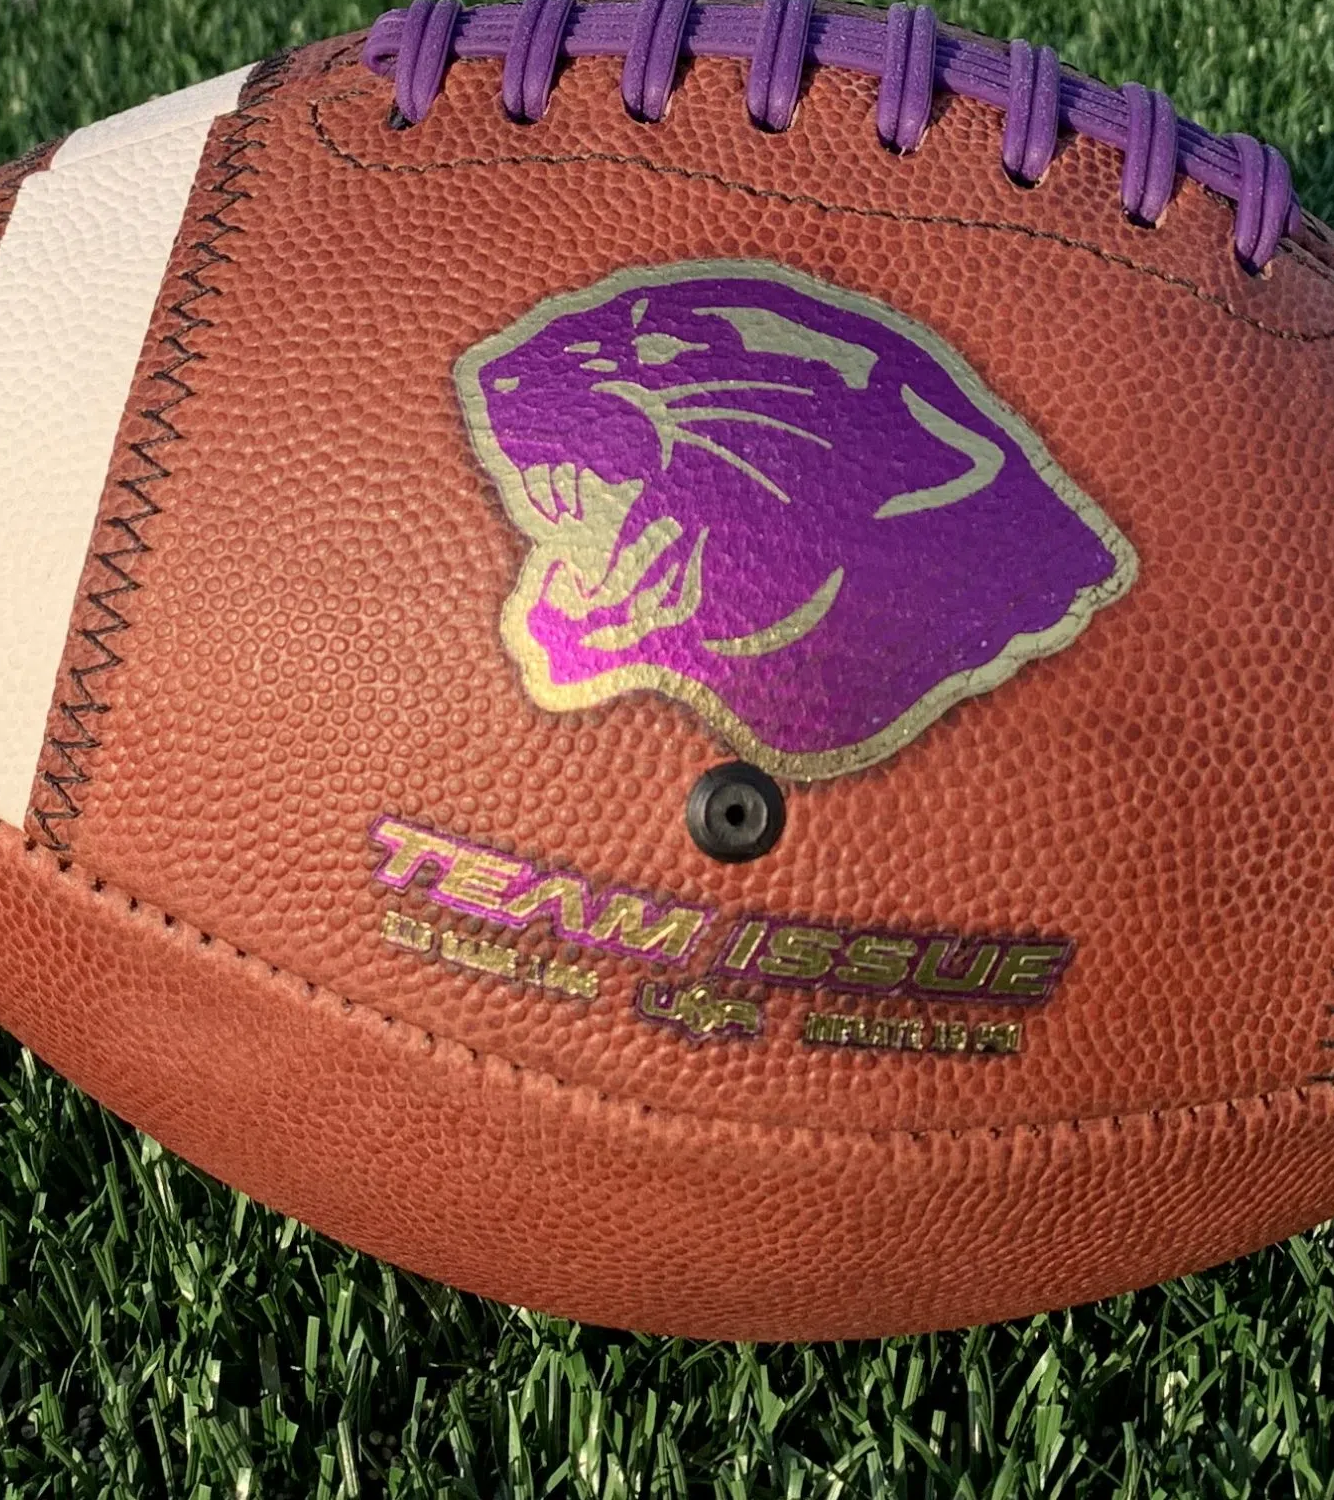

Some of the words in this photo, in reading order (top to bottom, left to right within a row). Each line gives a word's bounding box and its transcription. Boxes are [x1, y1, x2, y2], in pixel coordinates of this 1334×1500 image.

[373, 818, 709, 961] TEAM
[723, 918, 1067, 999] ISSUE
[804, 1011, 924, 1050] INFLATE
